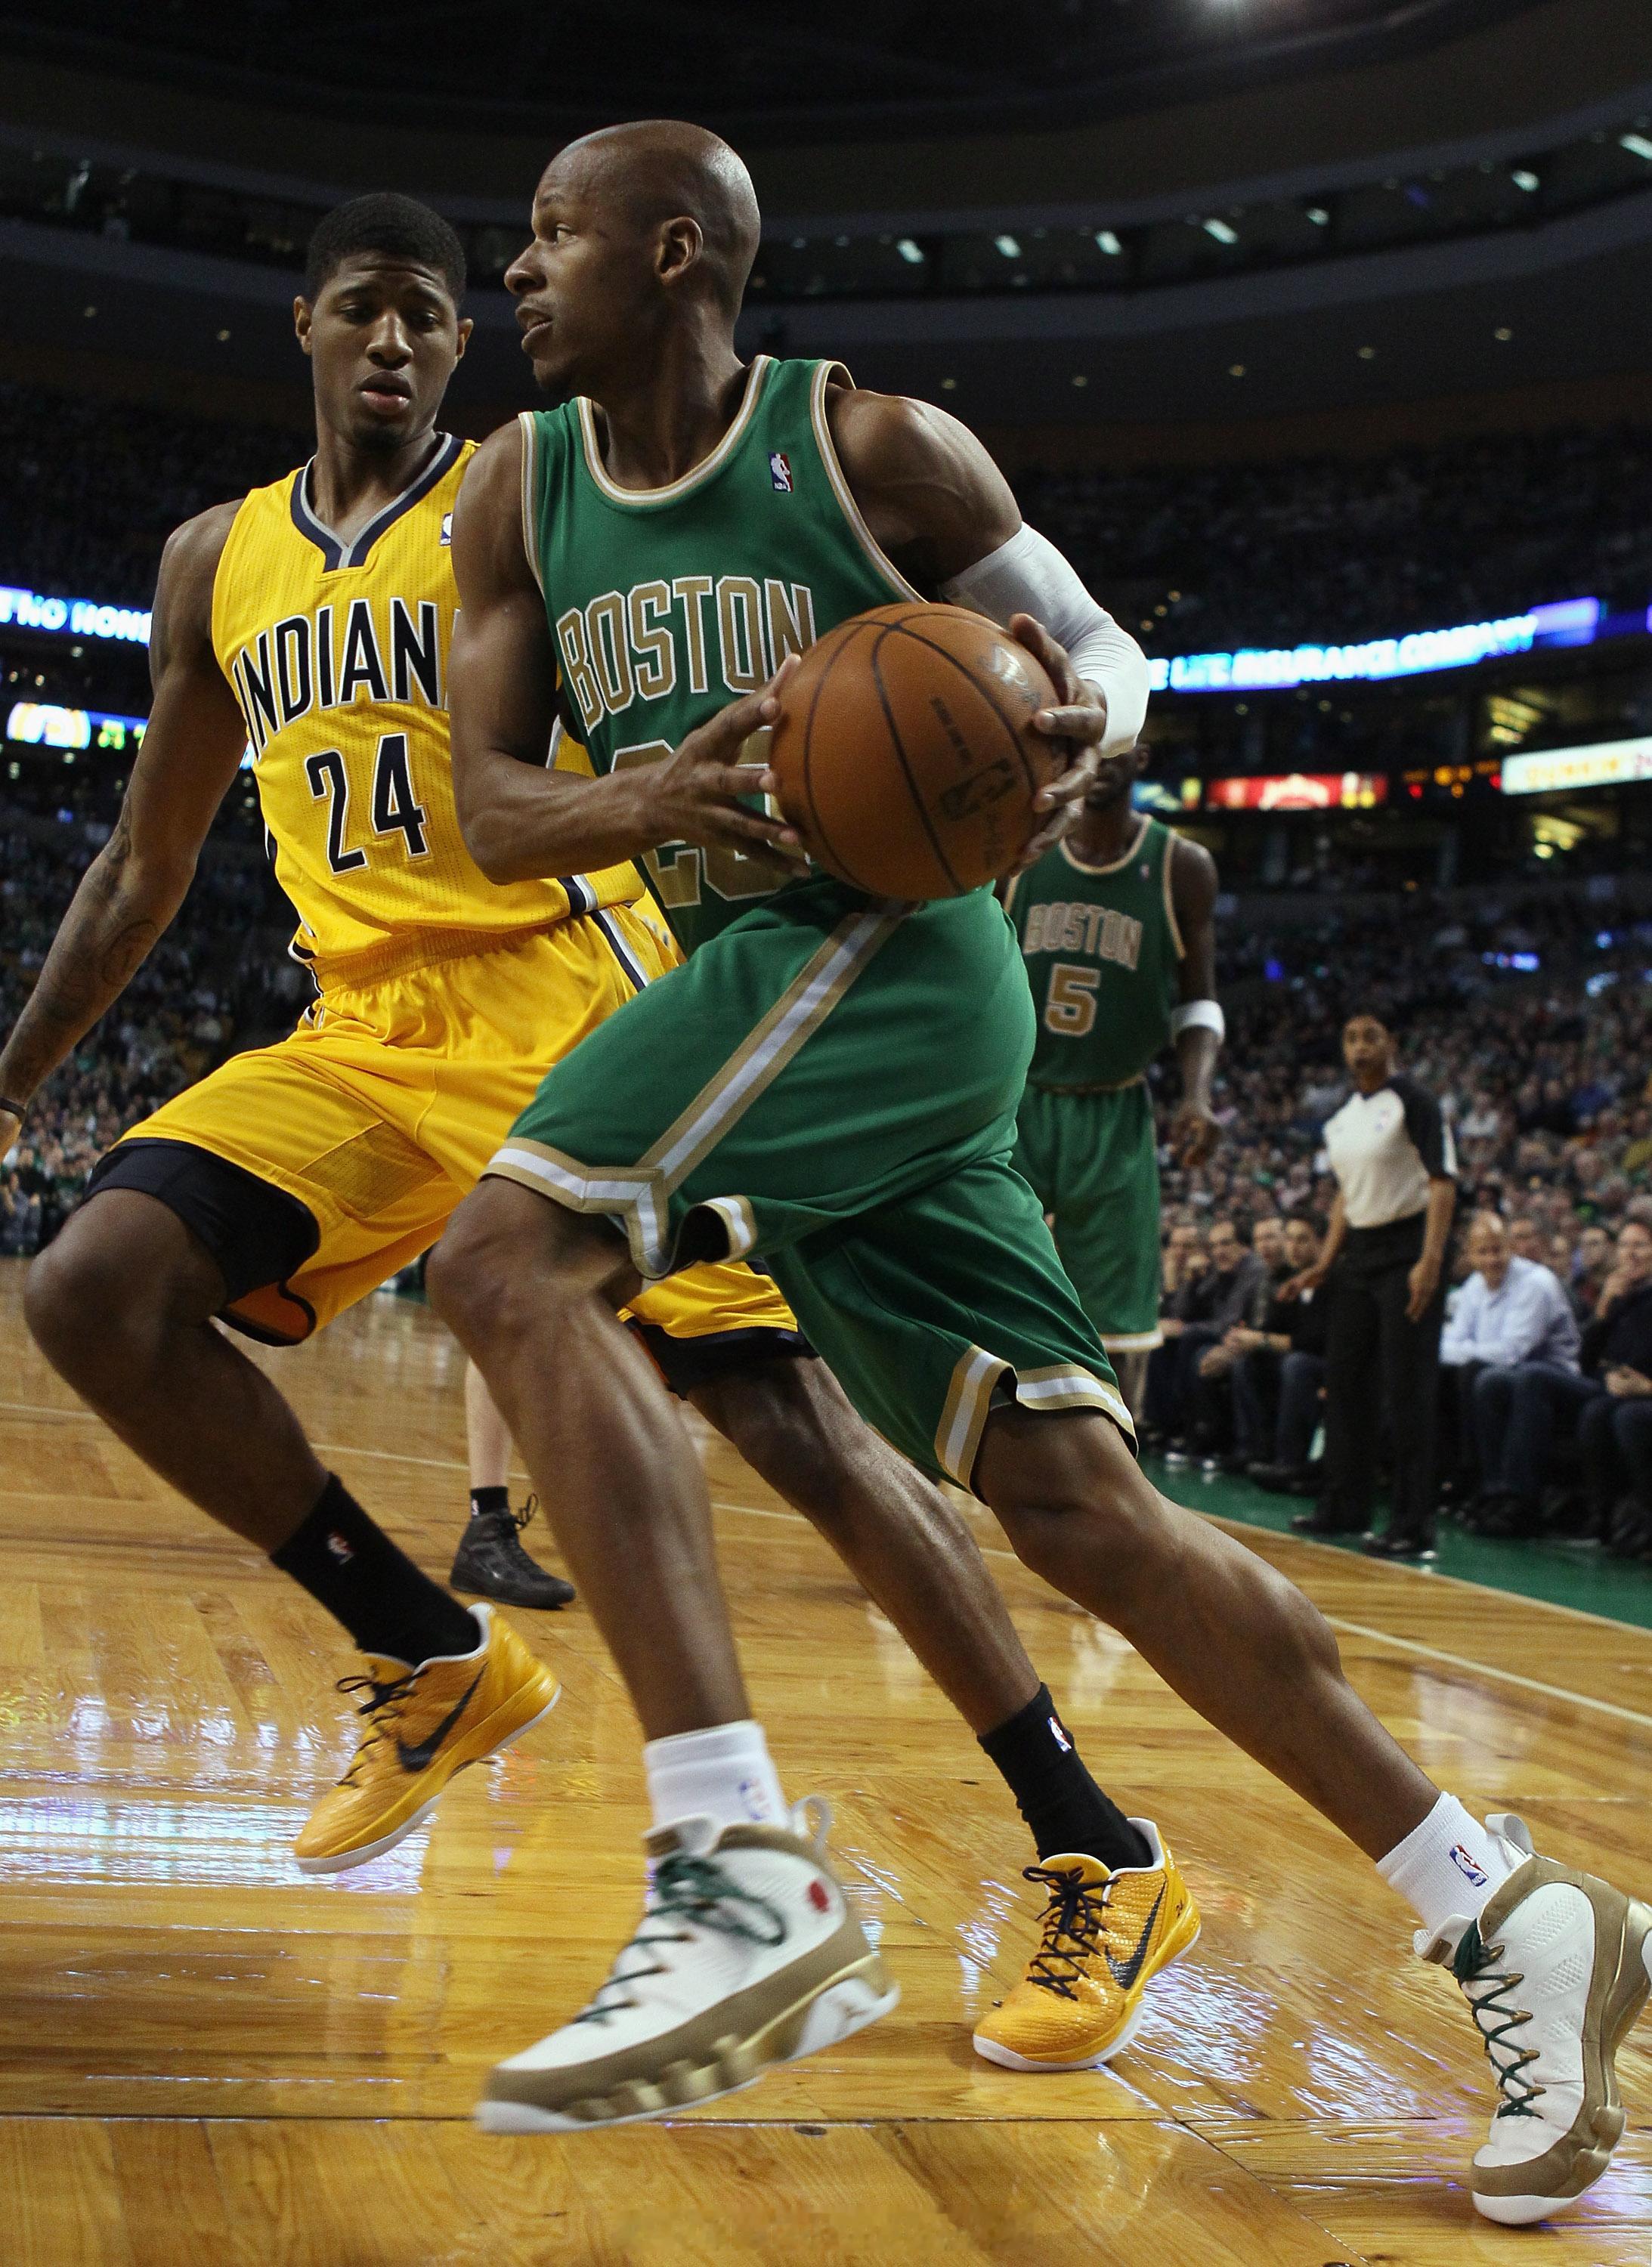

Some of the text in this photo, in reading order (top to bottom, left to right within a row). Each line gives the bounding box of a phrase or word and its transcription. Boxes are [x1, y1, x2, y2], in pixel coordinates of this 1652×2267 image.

[232, 597, 462, 765] INDIAN
[555, 575, 817, 736] BOSTON
[1232, 641, 1398, 684] INSURANCE
[1398, 614, 1539, 670] COMPANY
[305, 731, 431, 877] 24
[1022, 902, 1143, 972] BOSTON
[1044, 962, 1101, 1038] 5
